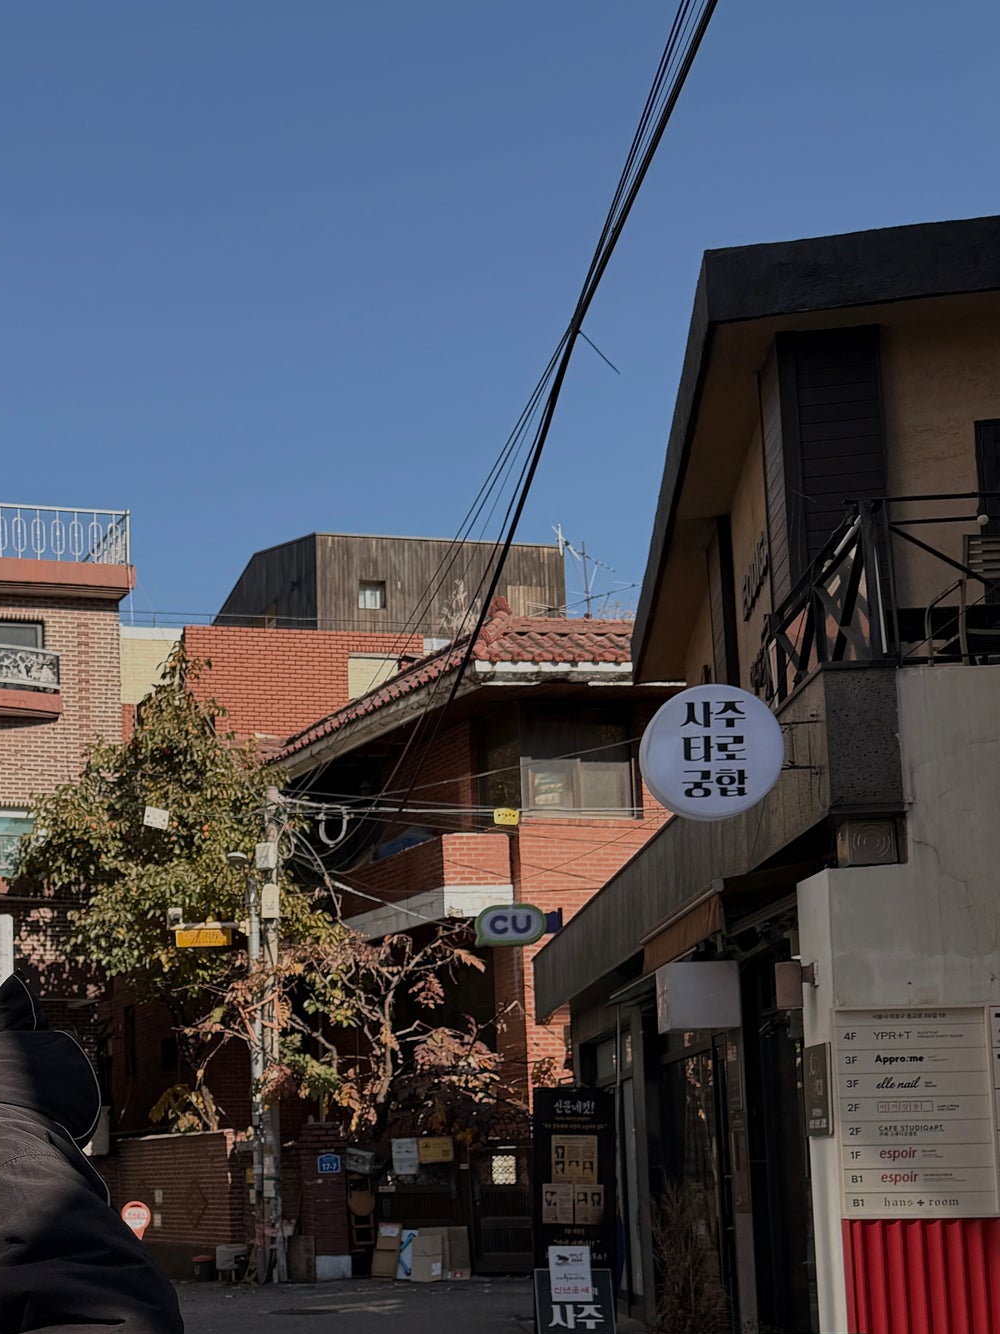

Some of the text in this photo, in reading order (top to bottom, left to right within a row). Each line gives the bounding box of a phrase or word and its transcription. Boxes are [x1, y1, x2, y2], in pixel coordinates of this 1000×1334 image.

[680, 700, 746, 728] 사주
[681, 735, 747, 762] 타로
[681, 769, 748, 798] 궁합
[490, 915, 531, 935] CU
[843, 1032, 857, 1040] 4F
[873, 1031, 912, 1040] YPR+T
[845, 1056, 858, 1064] 3F
[846, 1079, 859, 1088] 3F
[876, 1077, 896, 1089] elle
[897, 1076, 921, 1089] nail
[847, 1103, 860, 1112] 2F
[848, 1127, 861, 1136] 2F
[850, 1151, 861, 1160] 1F
[879, 1147, 917, 1162] espoir
[851, 1175, 863, 1183] B1
[881, 1171, 919, 1186] espoir
[853, 1199, 864, 1207] B1
[548, 1304, 605, 1330] 사주
